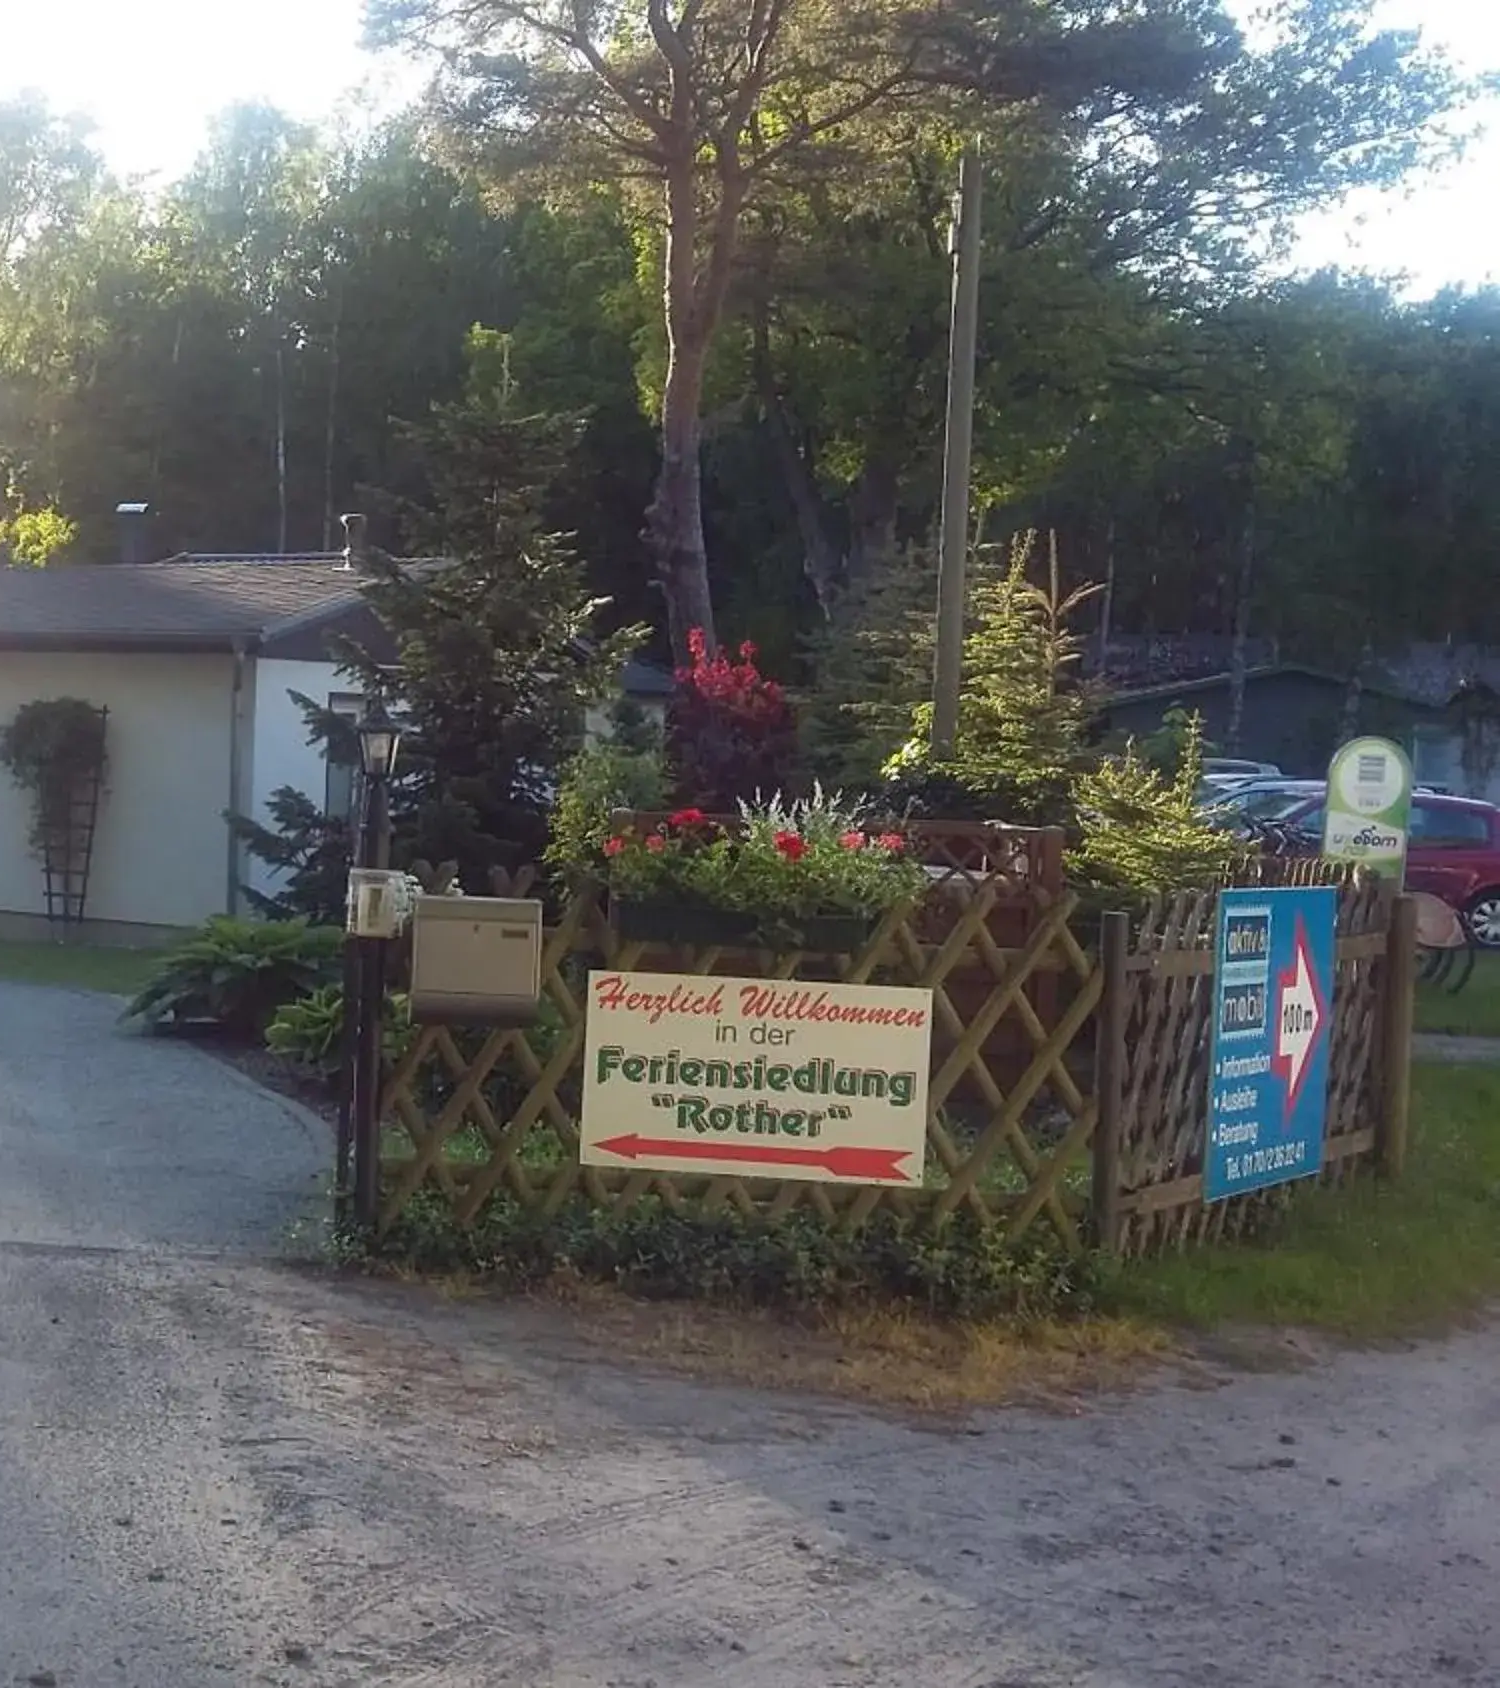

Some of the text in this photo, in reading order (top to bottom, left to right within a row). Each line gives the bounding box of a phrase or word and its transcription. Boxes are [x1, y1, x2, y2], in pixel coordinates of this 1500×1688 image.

[1228, 924, 1258, 954] aktiv
[595, 976, 926, 1028] Herzlich Willkommen
[1224, 987, 1264, 1024] mobil
[715, 1019, 796, 1046] in der
[597, 1045, 917, 1106] Feriensiedlung
[1222, 1052, 1271, 1079] Information
[1219, 1086, 1257, 1113] Ausleihe
[1219, 1120, 1259, 1147] Beratung
